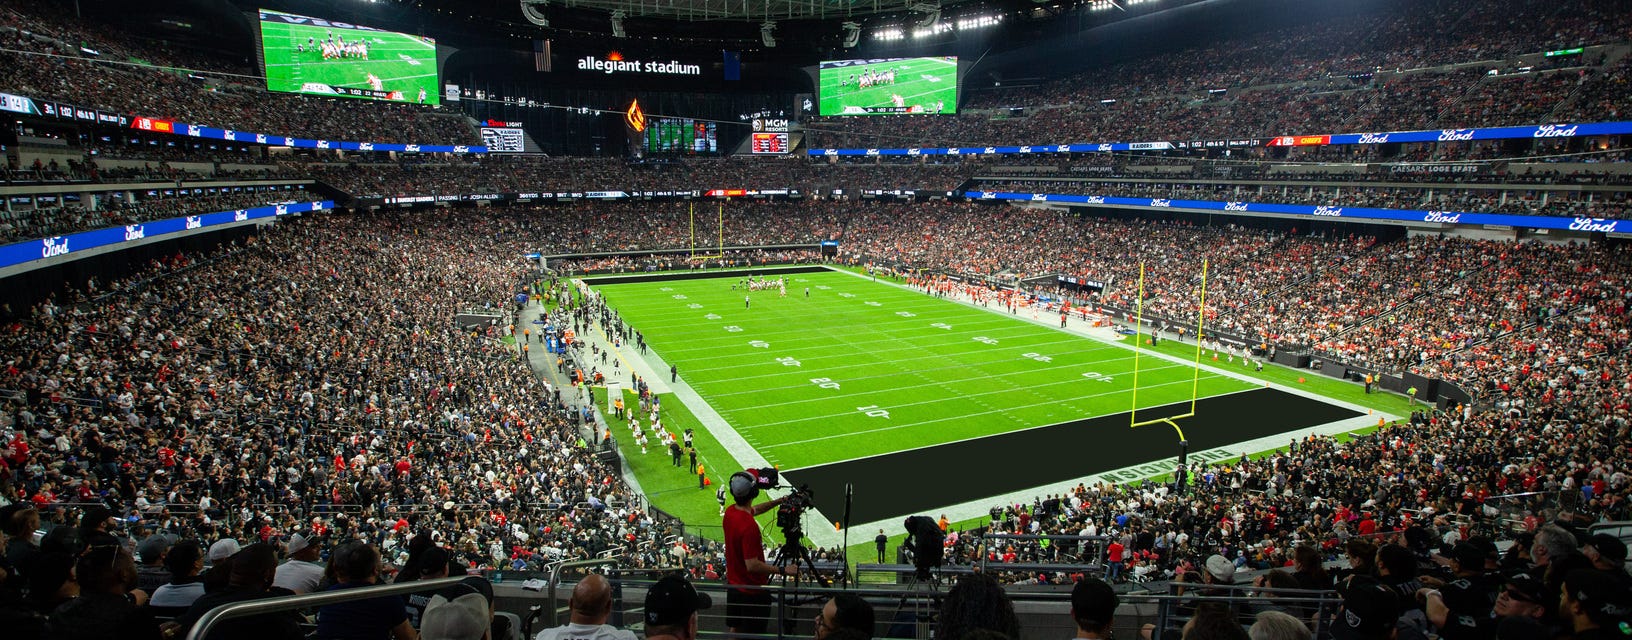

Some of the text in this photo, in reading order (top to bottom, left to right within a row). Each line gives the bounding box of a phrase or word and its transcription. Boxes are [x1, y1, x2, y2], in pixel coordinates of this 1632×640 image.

[578, 56, 700, 74] allegiant stadium
[60, 106, 72, 118] 1:02
[1438, 129, 1474, 141] Ford
[1534, 124, 1578, 138] Ford
[1358, 133, 1389, 144] Ford
[405, 144, 420, 152] Ford
[984, 146, 996, 154] Ford
[1020, 145, 1032, 154] Ford
[1057, 144, 1071, 152] Ford
[1098, 143, 1113, 152] Ford
[982, 191, 996, 199] Ford
[1032, 193, 1048, 201] Ford
[1088, 196, 1105, 204] Ford
[1150, 198, 1172, 208] Ford
[1224, 202, 1248, 212] Ford
[1313, 205, 1342, 216] Ford
[1424, 211, 1460, 224] Ford
[1569, 217, 1618, 232] Ford
[42, 236, 70, 258] Ford
[810, 377, 840, 390] 20
[857, 404, 890, 419] 10
